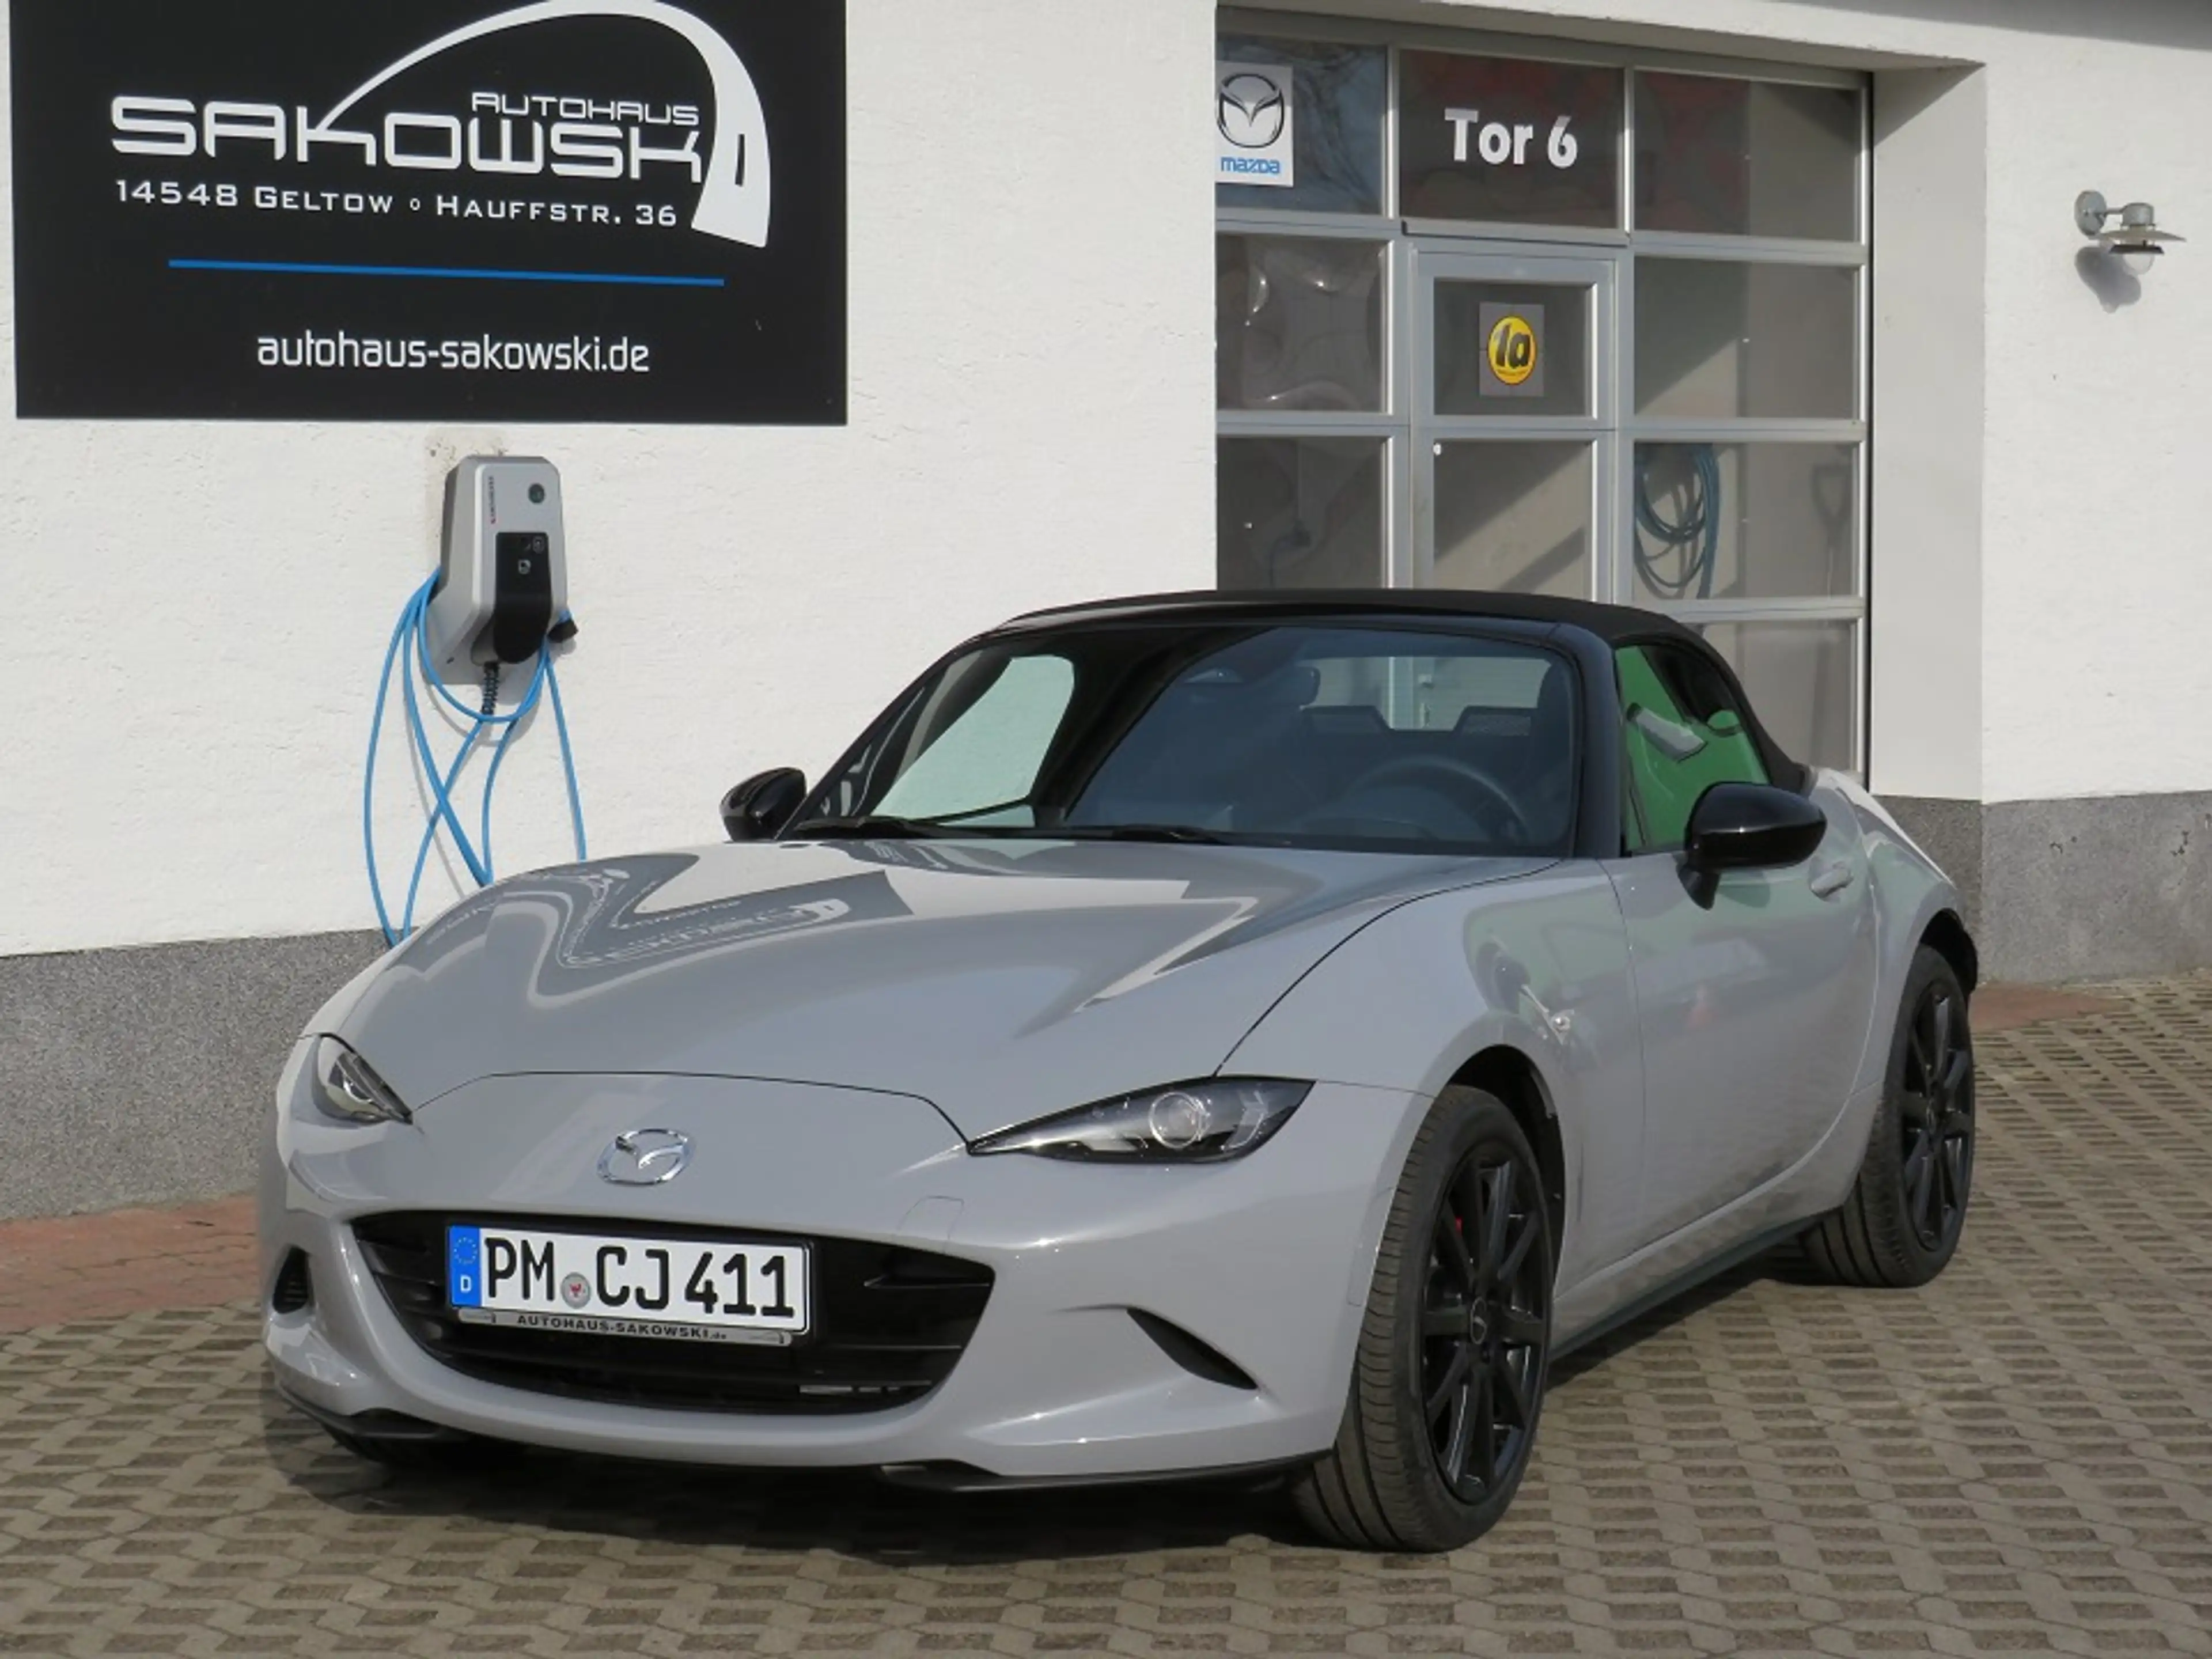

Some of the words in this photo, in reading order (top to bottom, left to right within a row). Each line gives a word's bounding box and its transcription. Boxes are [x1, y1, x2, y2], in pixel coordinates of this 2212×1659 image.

[471, 92, 699, 126] AUTOHAUS
[1444, 106, 1534, 165] Tor
[1547, 115, 1578, 169] 6
[116, 179, 238, 207] 14548
[635, 204, 677, 226] 36
[257, 329, 650, 373] autohaus-sakowski.de
[1496, 323, 1531, 369] 1a
[460, 1274, 472, 1293] D
[484, 1237, 555, 1301] PM
[597, 1245, 669, 1310] CJ
[684, 1251, 794, 1319] 411
